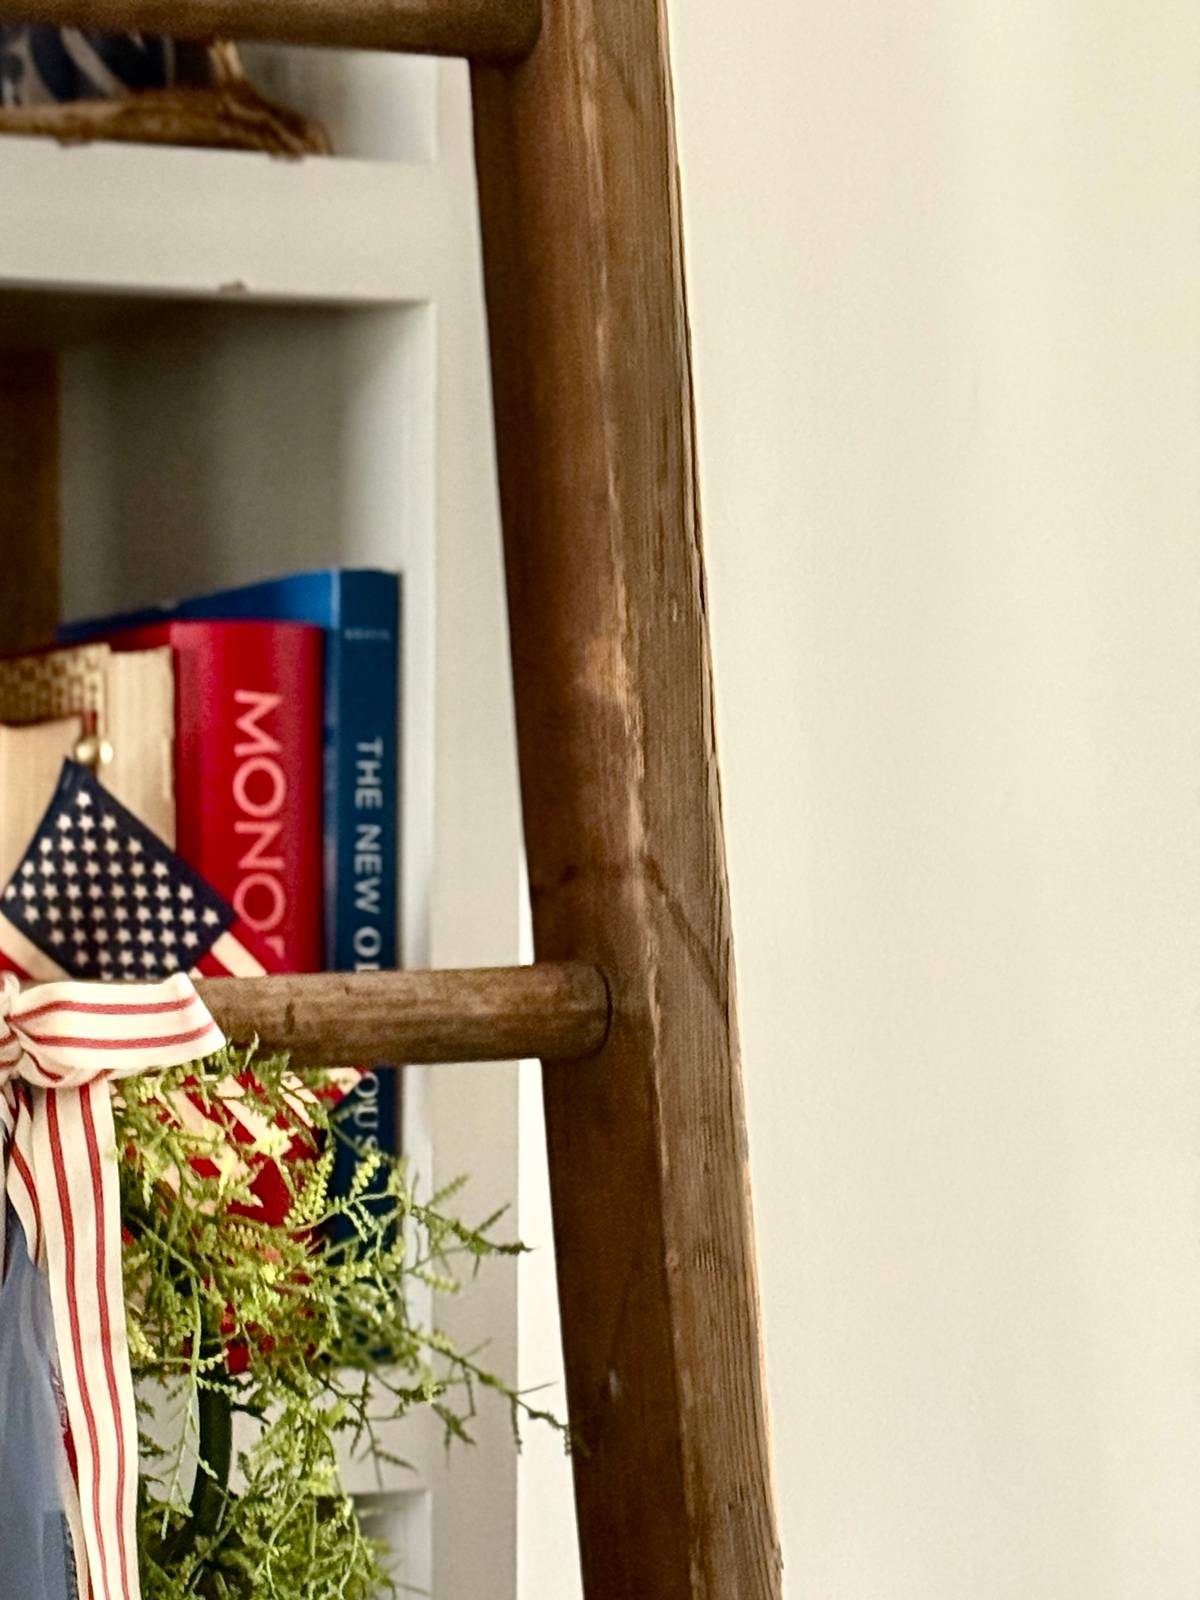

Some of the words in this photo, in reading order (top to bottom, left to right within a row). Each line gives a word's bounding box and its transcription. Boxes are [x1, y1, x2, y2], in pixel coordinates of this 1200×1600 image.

[355, 737, 384, 810] THE
[354, 825, 383, 914] NEW
[353, 926, 383, 971] O
